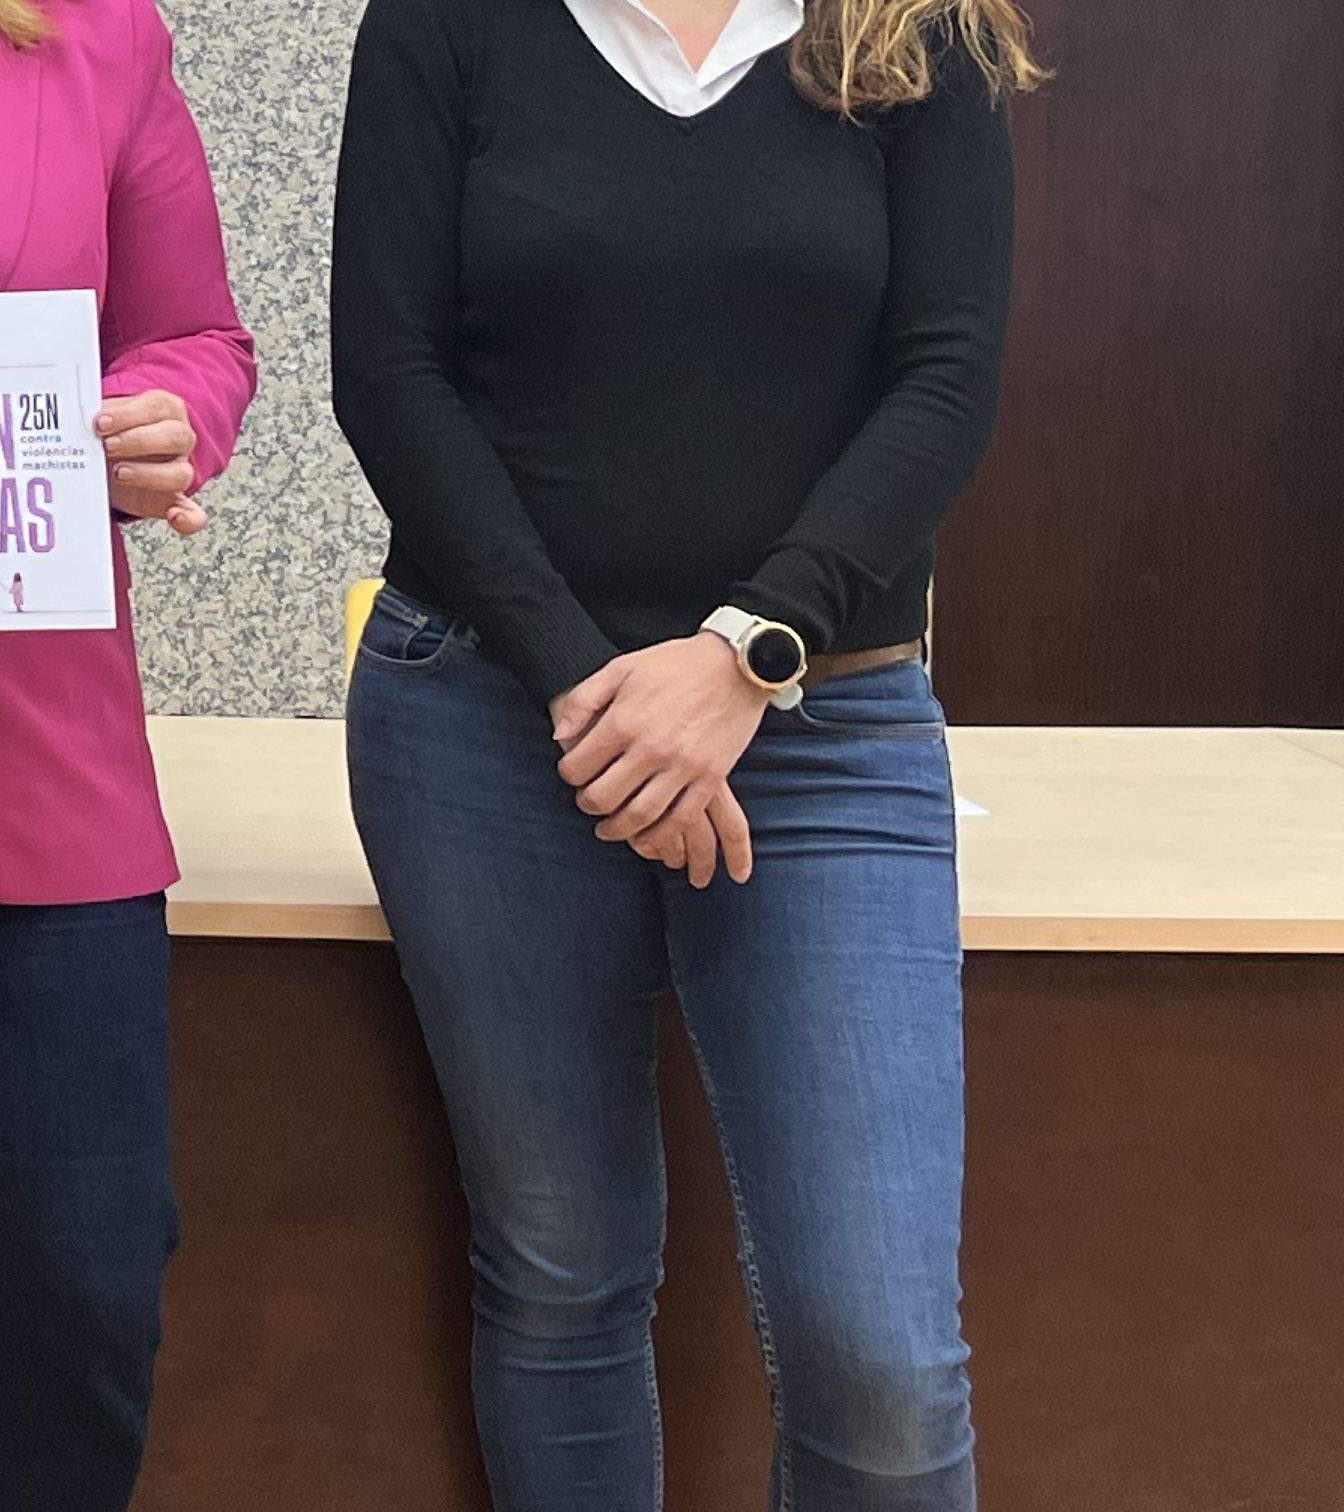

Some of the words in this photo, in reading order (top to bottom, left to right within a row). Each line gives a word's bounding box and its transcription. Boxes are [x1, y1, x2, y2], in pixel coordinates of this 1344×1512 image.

[19, 393, 59, 431] 25N
[20, 433, 62, 444] contra
[21, 446, 85, 457] violencias
[21, 459, 86, 470] machistas
